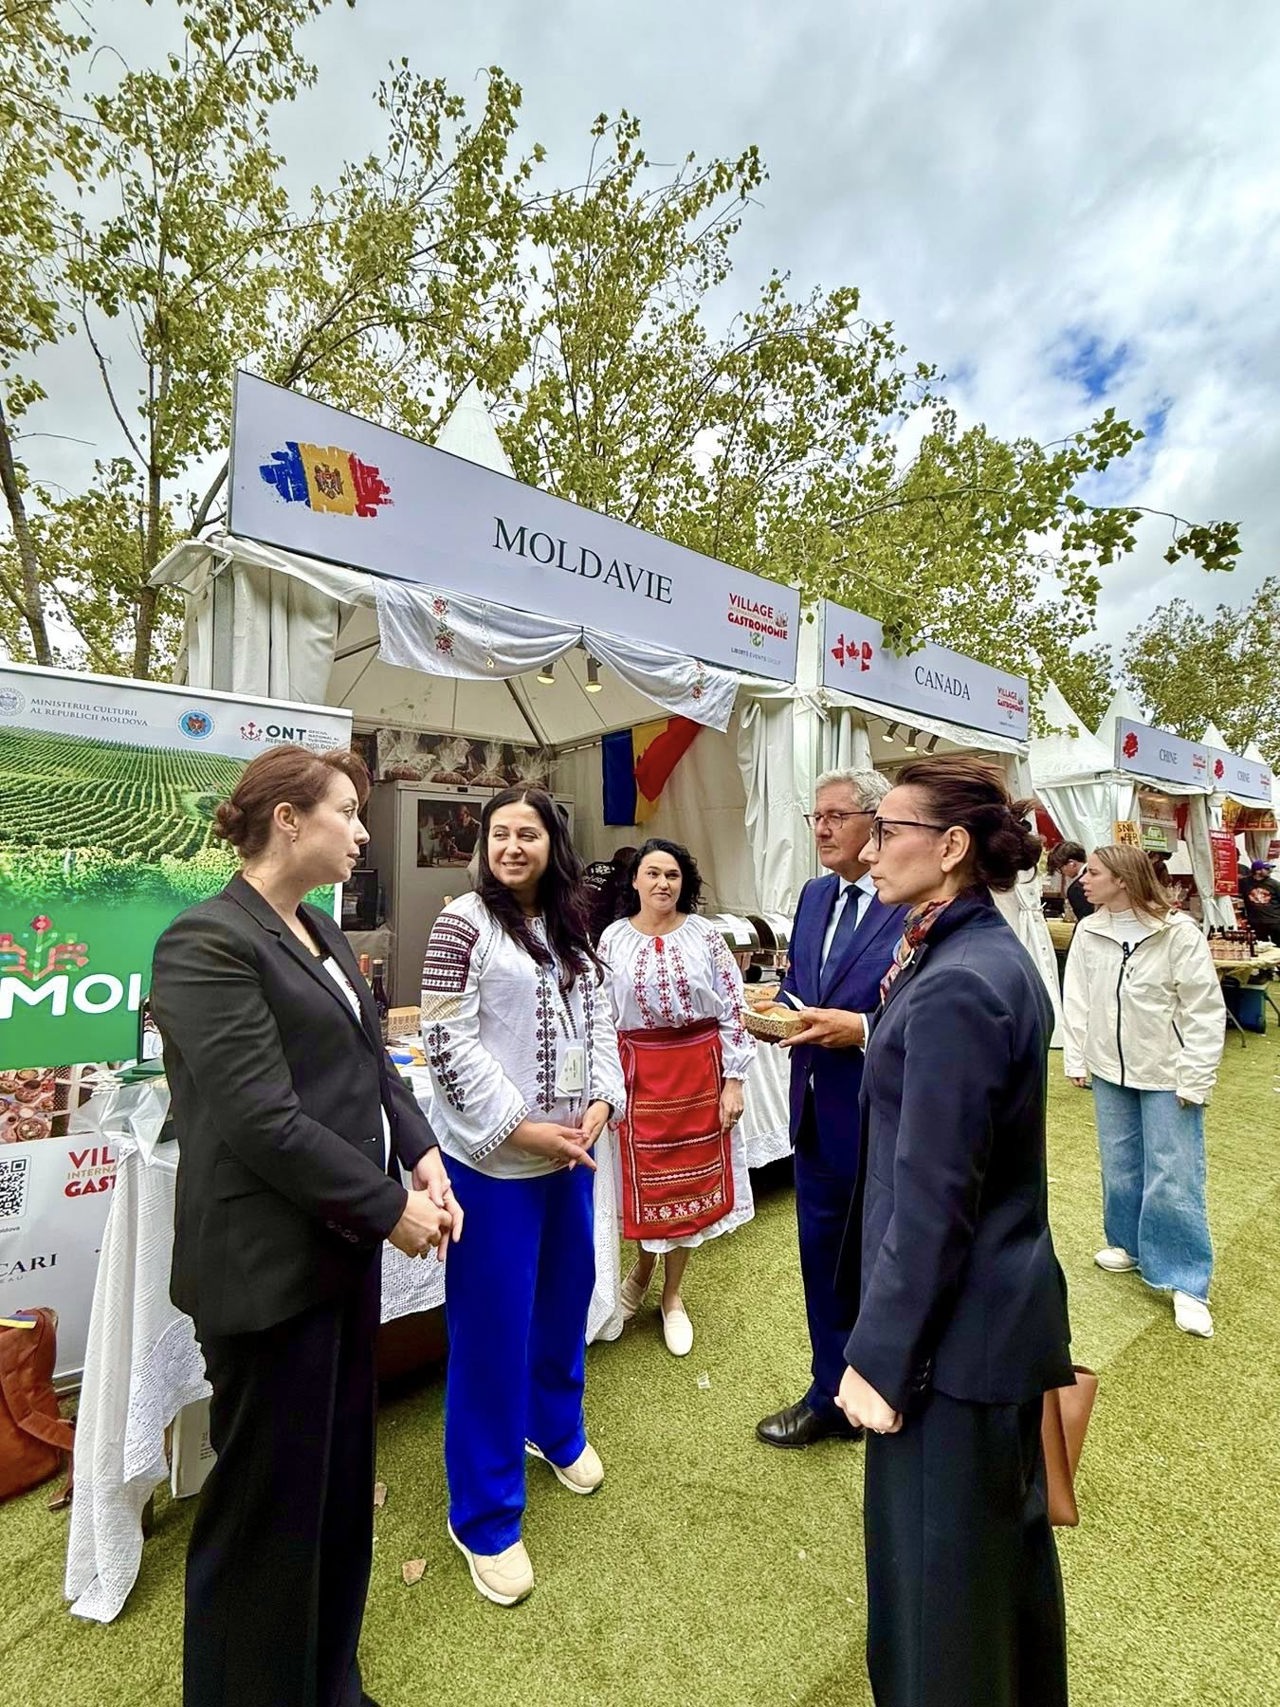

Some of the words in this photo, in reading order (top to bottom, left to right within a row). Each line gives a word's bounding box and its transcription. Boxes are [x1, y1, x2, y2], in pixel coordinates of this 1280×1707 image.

[493, 516, 673, 604] MOLDAVIE
[729, 593, 774, 619] VILLAGE
[728, 612, 788, 640] GASTRONOMIE
[915, 666, 970, 700] CANADA
[30, 707, 42, 715] AL
[45, 708, 98, 721] REPUBLICII
[101, 715, 148, 727] MOLDOVA
[31, 699, 90, 711] MINISTERUL
[93, 705, 138, 717] CULTURII
[266, 725, 306, 740] ONT
[1159, 748, 1179, 765] CHINE
[68, 1146, 116, 1169] VIL
[67, 1164, 117, 1179] INTERNA
[65, 1175, 117, 1197] GAST
[0, 1253, 58, 1276] CARI
